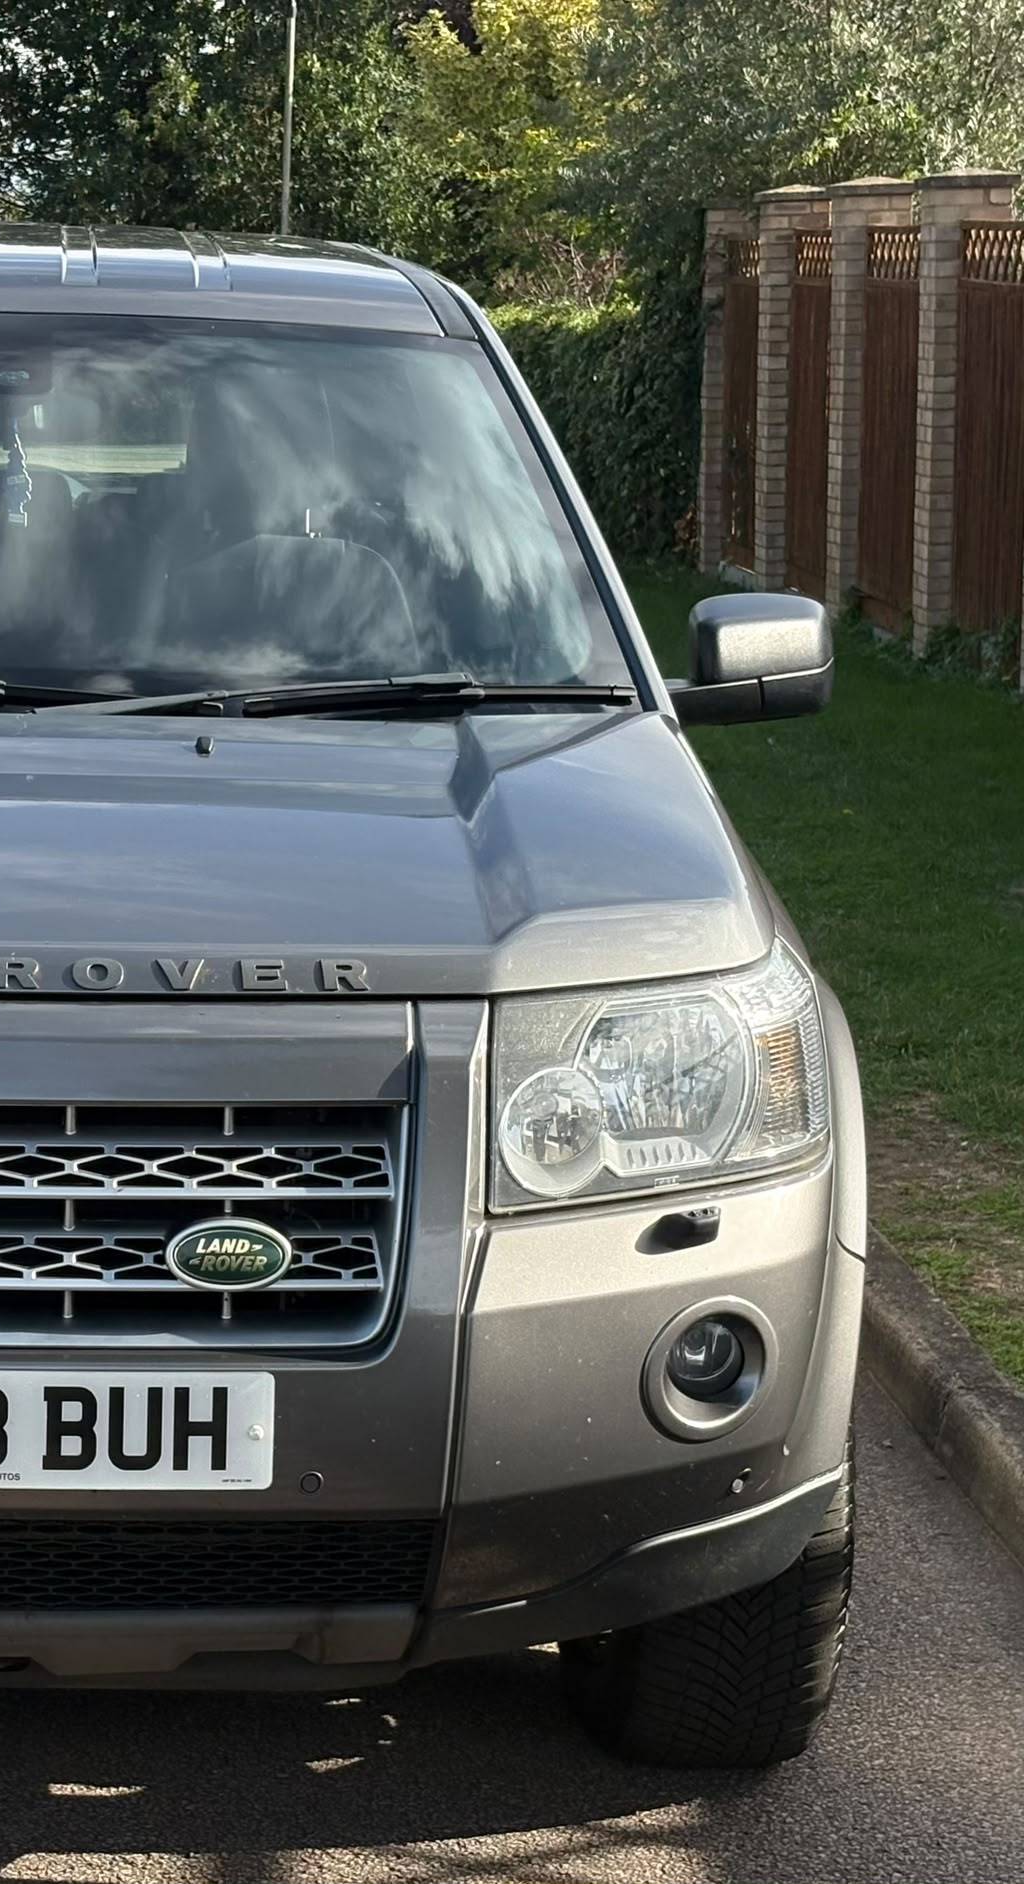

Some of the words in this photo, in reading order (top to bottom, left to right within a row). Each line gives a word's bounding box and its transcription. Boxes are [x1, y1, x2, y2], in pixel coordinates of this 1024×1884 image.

[195, 1238, 251, 1254] LAND
[200, 1255, 268, 1272] ROVER
[41, 1385, 229, 1472] BUH
